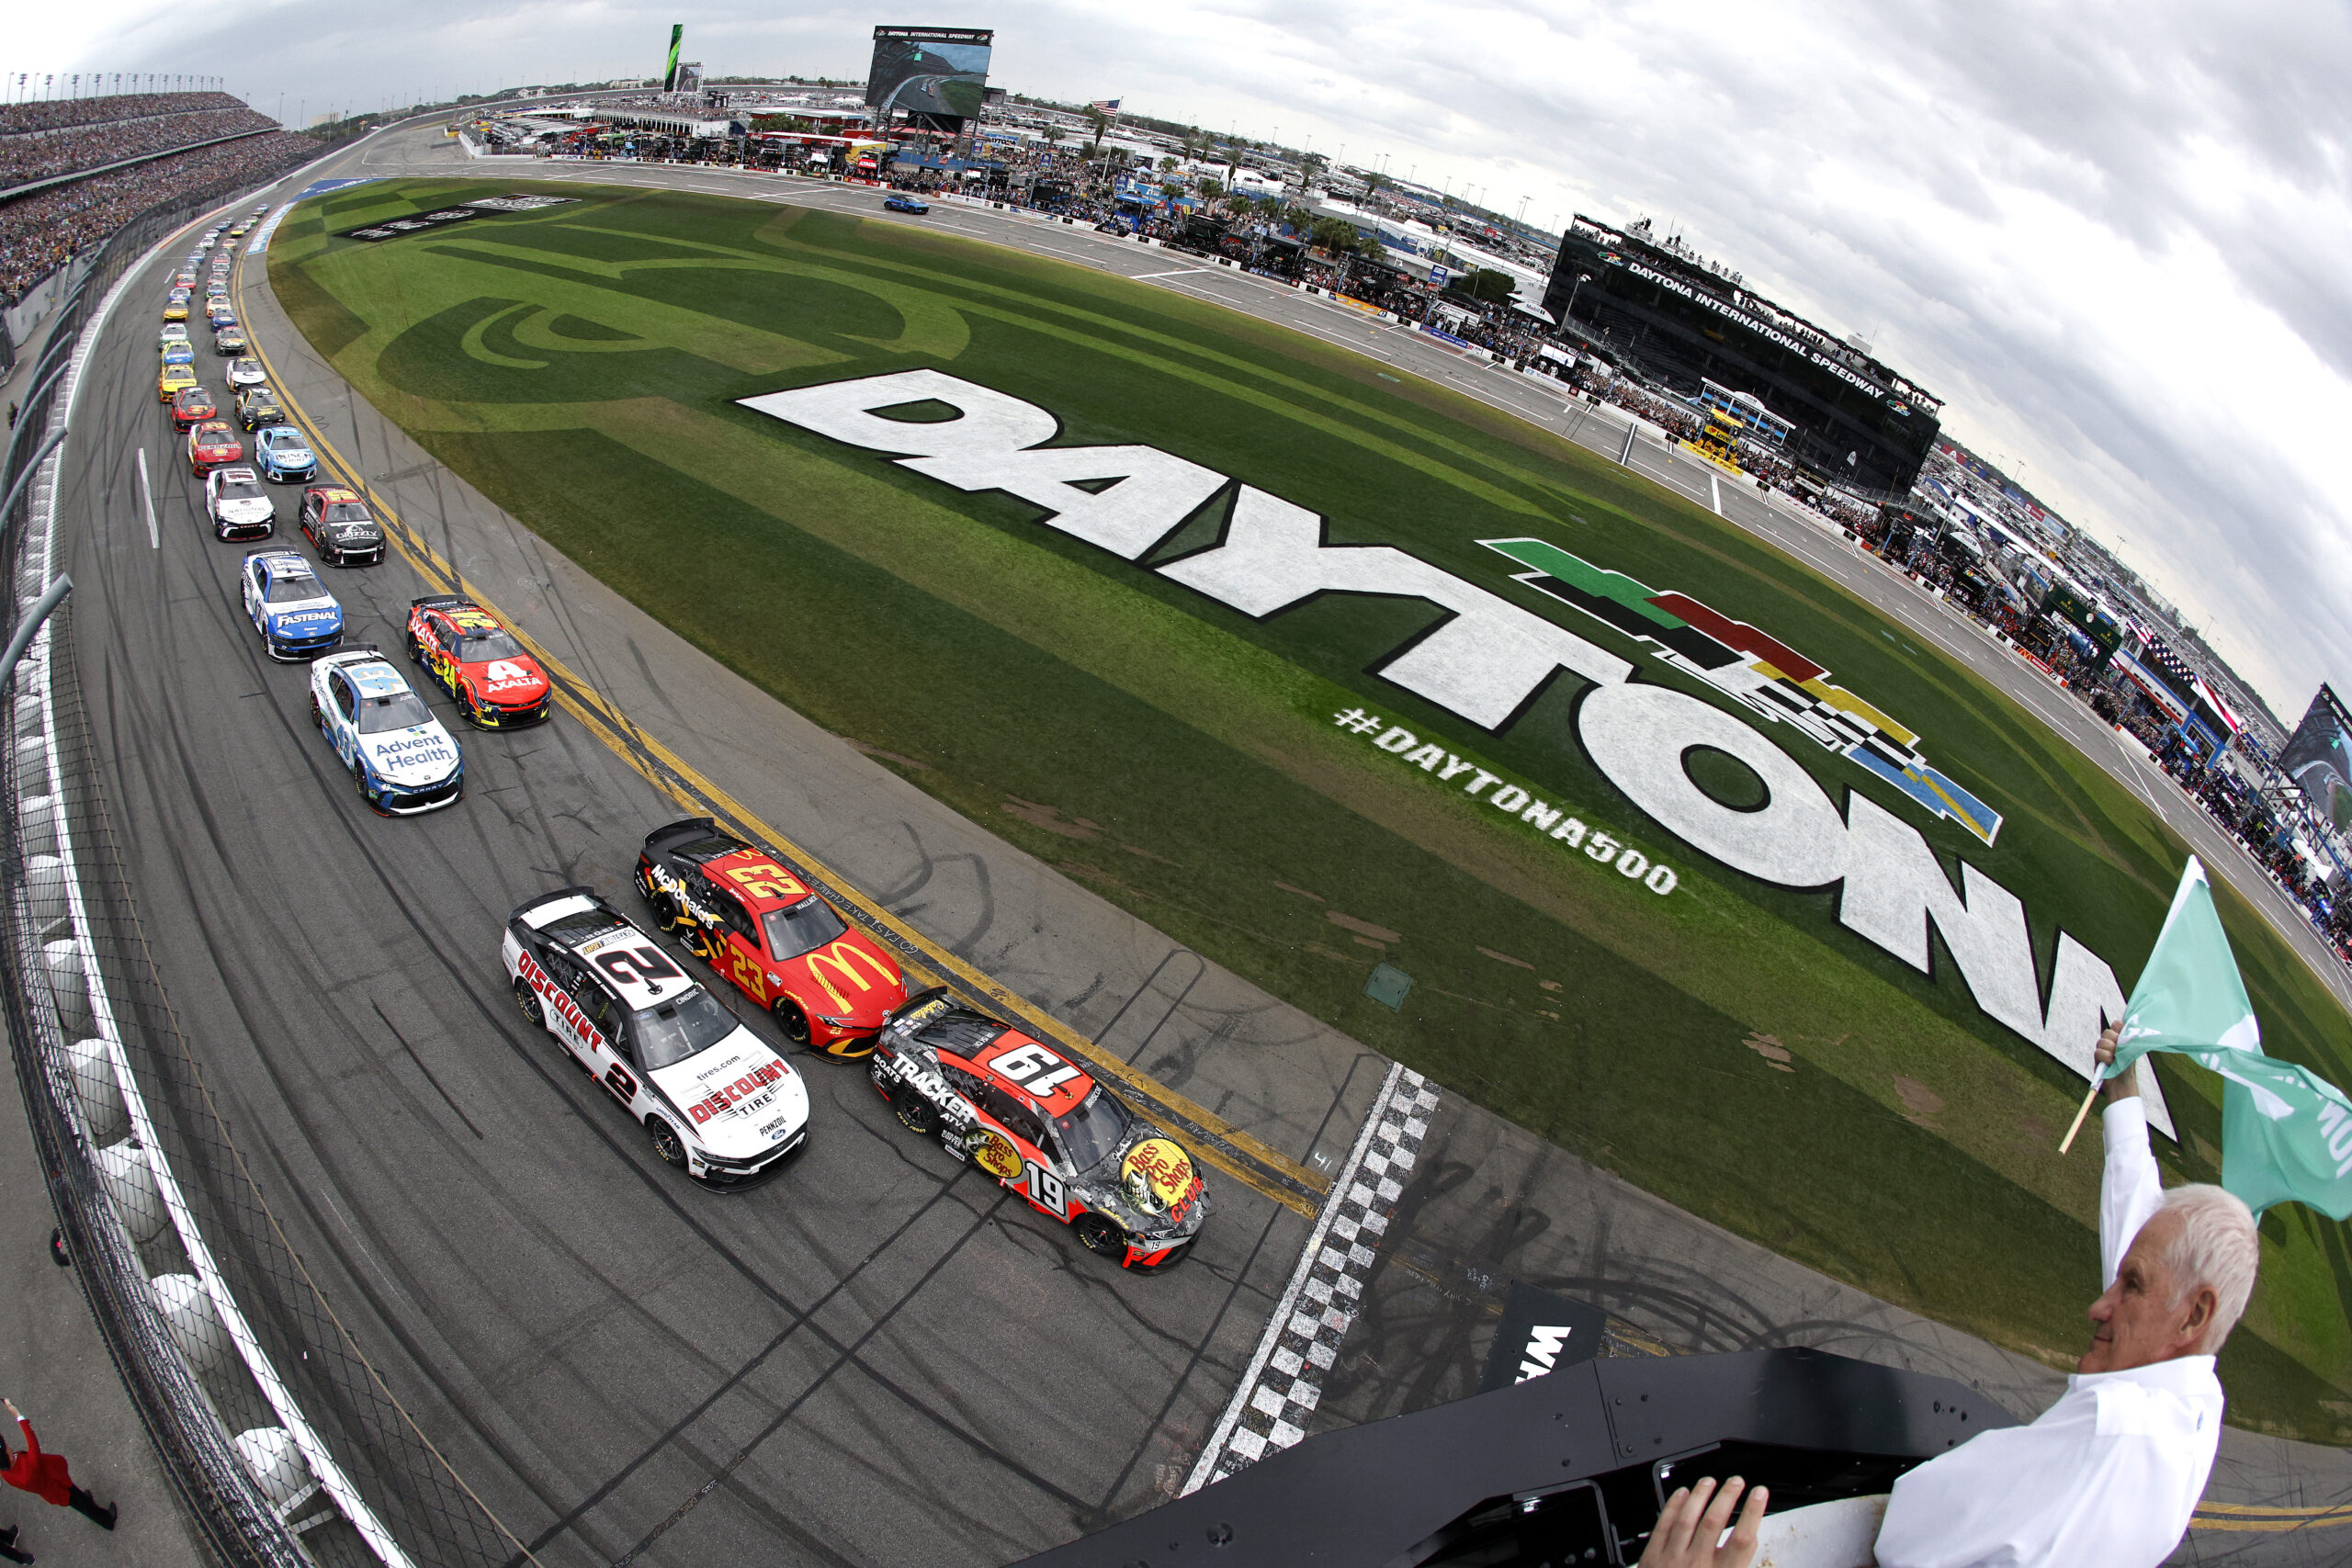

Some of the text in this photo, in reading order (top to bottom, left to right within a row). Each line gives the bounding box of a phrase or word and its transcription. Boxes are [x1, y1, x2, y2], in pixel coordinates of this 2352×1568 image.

[1628, 262, 1884, 400] DAYTONA INTERNATIONAL SPEEDWAY
[276, 452, 312, 461] BUSCH
[336, 530, 378, 539] GRIZZLY
[277, 610, 338, 628] FASTENAL
[410, 617, 437, 654] AXALTA
[352, 666, 403, 694] 43
[443, 658, 457, 698] 24
[488, 676, 543, 693] AXALTA
[377, 735, 444, 757] Advent
[386, 748, 454, 772] Health
[413, 784, 443, 794] CAMRY
[1332, 706, 1679, 897] #DAYTONA500
[725, 863, 807, 898] 23
[804, 874, 845, 904] CHANCES
[796, 895, 819, 910] WALLACE
[843, 902, 869, 922] TAKE
[582, 940, 604, 955] LIGHT
[900, 941, 919, 953] GO
[595, 946, 684, 985] 2
[729, 942, 767, 1003] 23
[518, 948, 606, 1054] DISCOUNT
[676, 988, 700, 1005] CINDRIC
[785, 989, 808, 1010] GOODYEAR
[553, 1011, 581, 1045] TIRE
[696, 1055, 741, 1081] tires.com
[873, 1054, 902, 1084] BOATS
[989, 1043, 1082, 1097] 19
[605, 1062, 638, 1106] 2
[688, 1058, 790, 1125] DISCOUNT
[891, 1052, 978, 1124] TRACKER
[739, 1093, 773, 1115] TIRE
[1086, 1086, 1102, 1108] BRISCOE
[656, 1107, 680, 1130] GOODYEAR
[759, 1115, 787, 1137] PENNZOIL
[939, 1112, 967, 1133] ATVs
[941, 1134, 962, 1148] COFFEE
[988, 1145, 1005, 1161] Pro
[989, 1135, 1013, 1157] Bass
[983, 1152, 1012, 1177] Shops
[1127, 1143, 1159, 1174] Bass
[1146, 1157, 1170, 1183] Pro
[1159, 1158, 1191, 1194] Shops
[1025, 1162, 1066, 1216] 19
[1170, 1176, 1204, 1224] CLUB
[1151, 1241, 1161, 1250] 19
